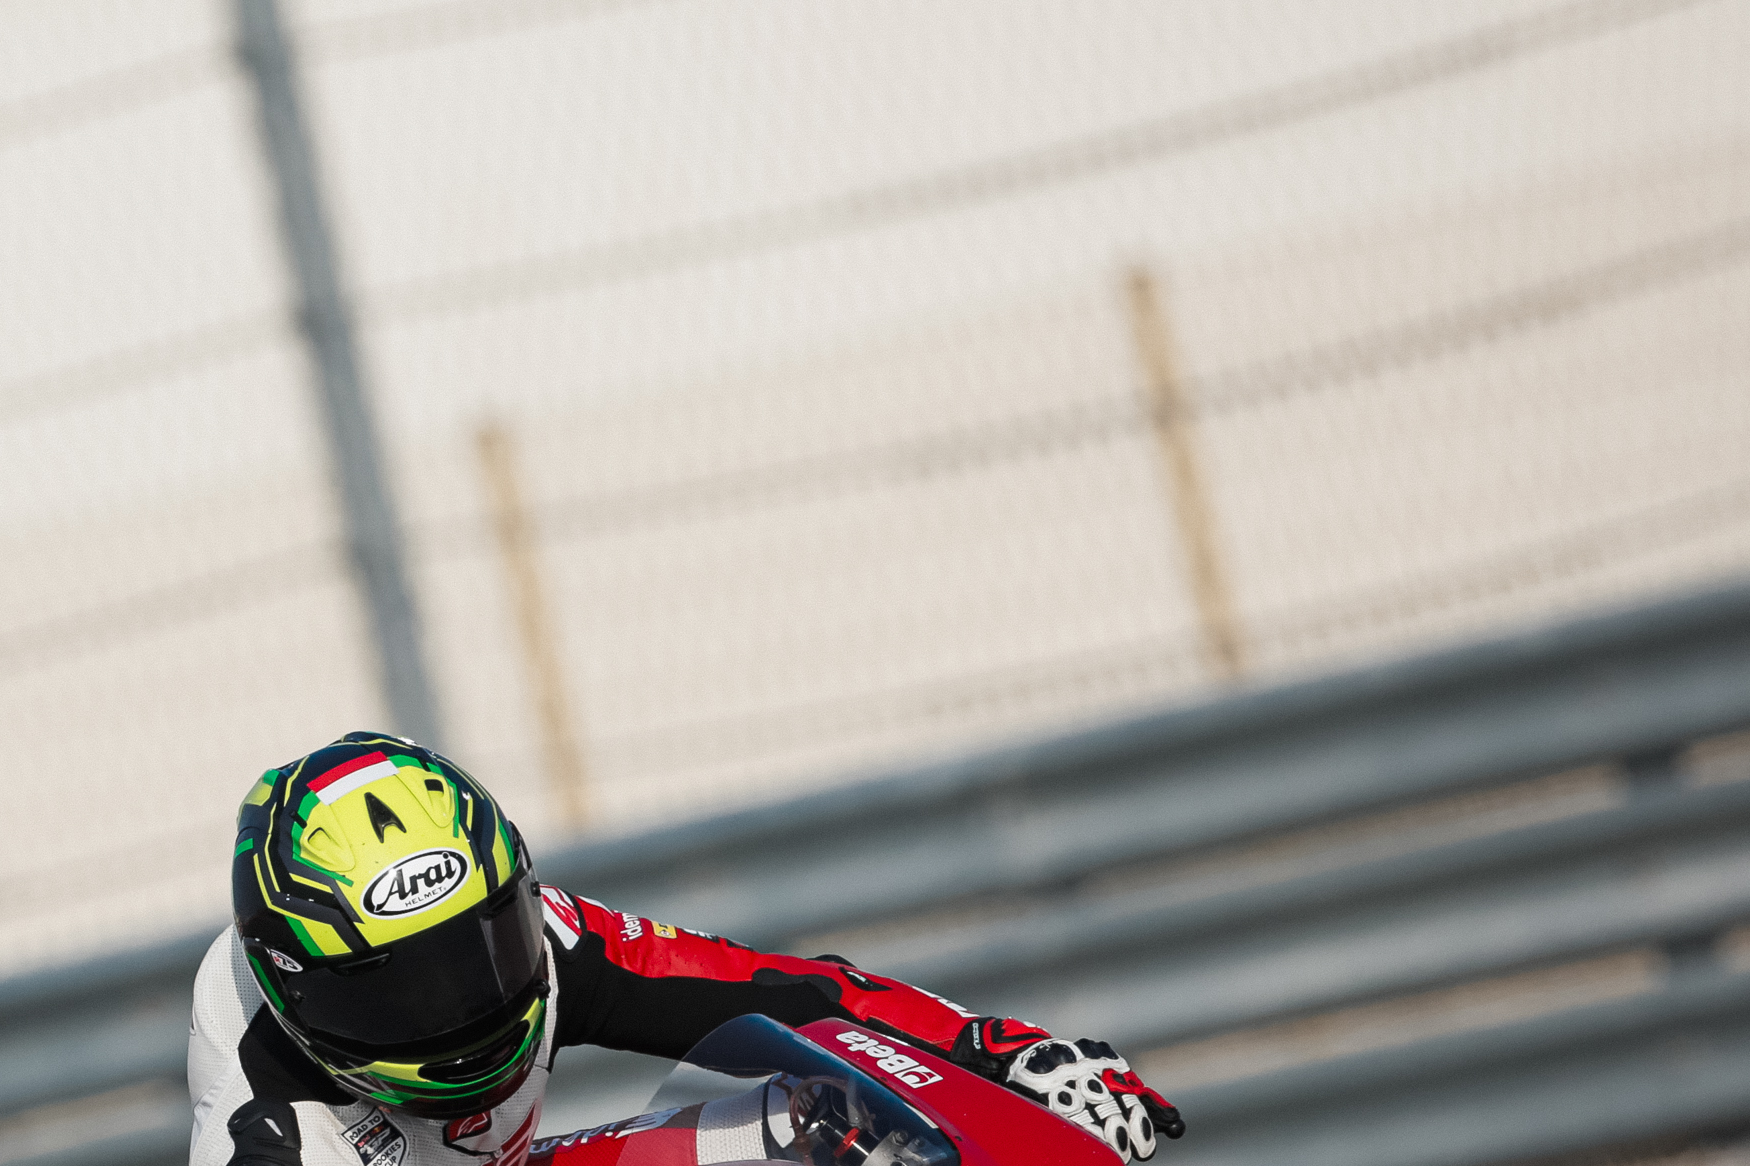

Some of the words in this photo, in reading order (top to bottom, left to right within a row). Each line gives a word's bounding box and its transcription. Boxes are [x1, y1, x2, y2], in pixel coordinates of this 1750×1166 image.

[374, 852, 458, 911] Arai
[404, 886, 444, 907] HELMET
[836, 1031, 920, 1074] Beta
[370, 1115, 381, 1126] TO
